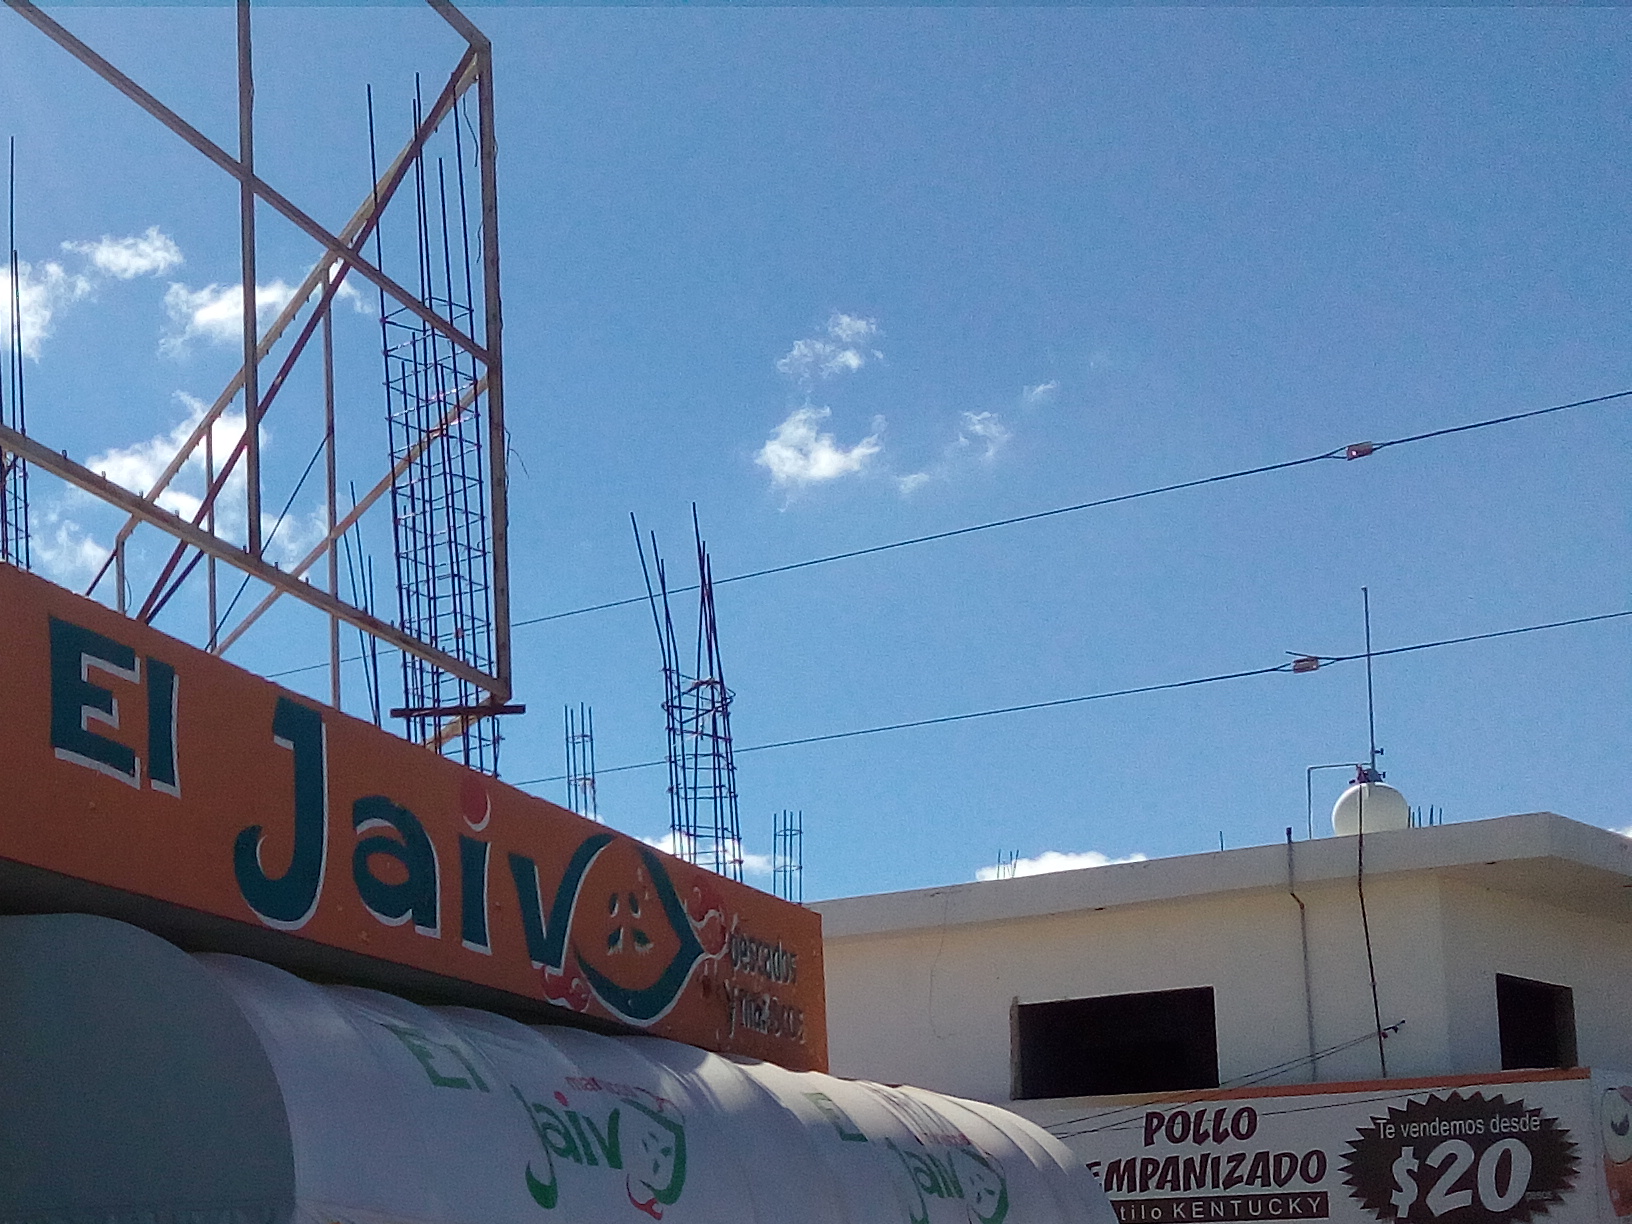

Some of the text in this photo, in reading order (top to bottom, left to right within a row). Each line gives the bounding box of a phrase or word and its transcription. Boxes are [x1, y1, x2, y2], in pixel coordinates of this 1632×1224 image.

[49, 614, 180, 798] El
[1144, 1106, 1258, 1147] POLLO
[1376, 1114, 1541, 1140] Te vendemos desde
[1390, 1138, 1533, 1218] $20
[1120, 1197, 1321, 1222] tilo KENTUCKY
